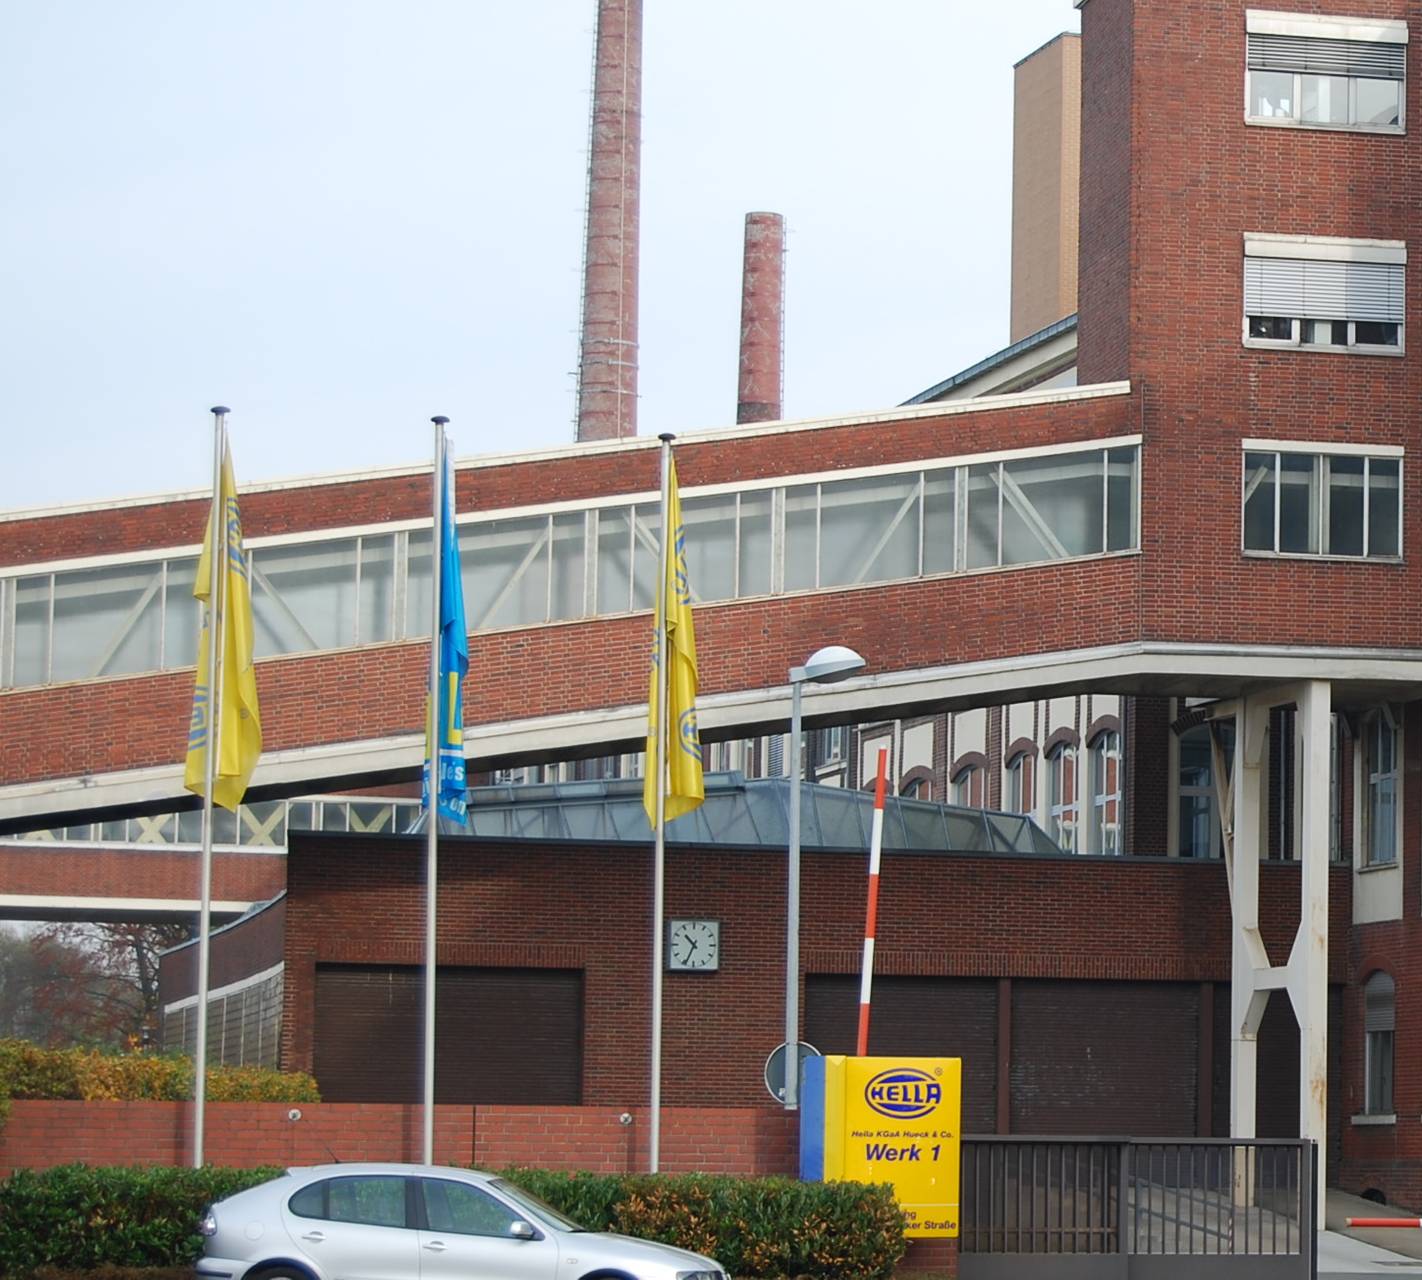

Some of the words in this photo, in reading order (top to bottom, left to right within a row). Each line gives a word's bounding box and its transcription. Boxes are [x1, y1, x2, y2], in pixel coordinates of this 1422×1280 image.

[871, 1083, 942, 1104] HELLA
[851, 1130, 874, 1138] Hella
[876, 1130, 900, 1138] KGaA
[903, 1130, 929, 1138] Hueck
[940, 1130, 954, 1138] Co.
[866, 1143, 922, 1161] Werk
[931, 1144, 941, 1161] 1
[924, 1220, 957, 1230] Straße
